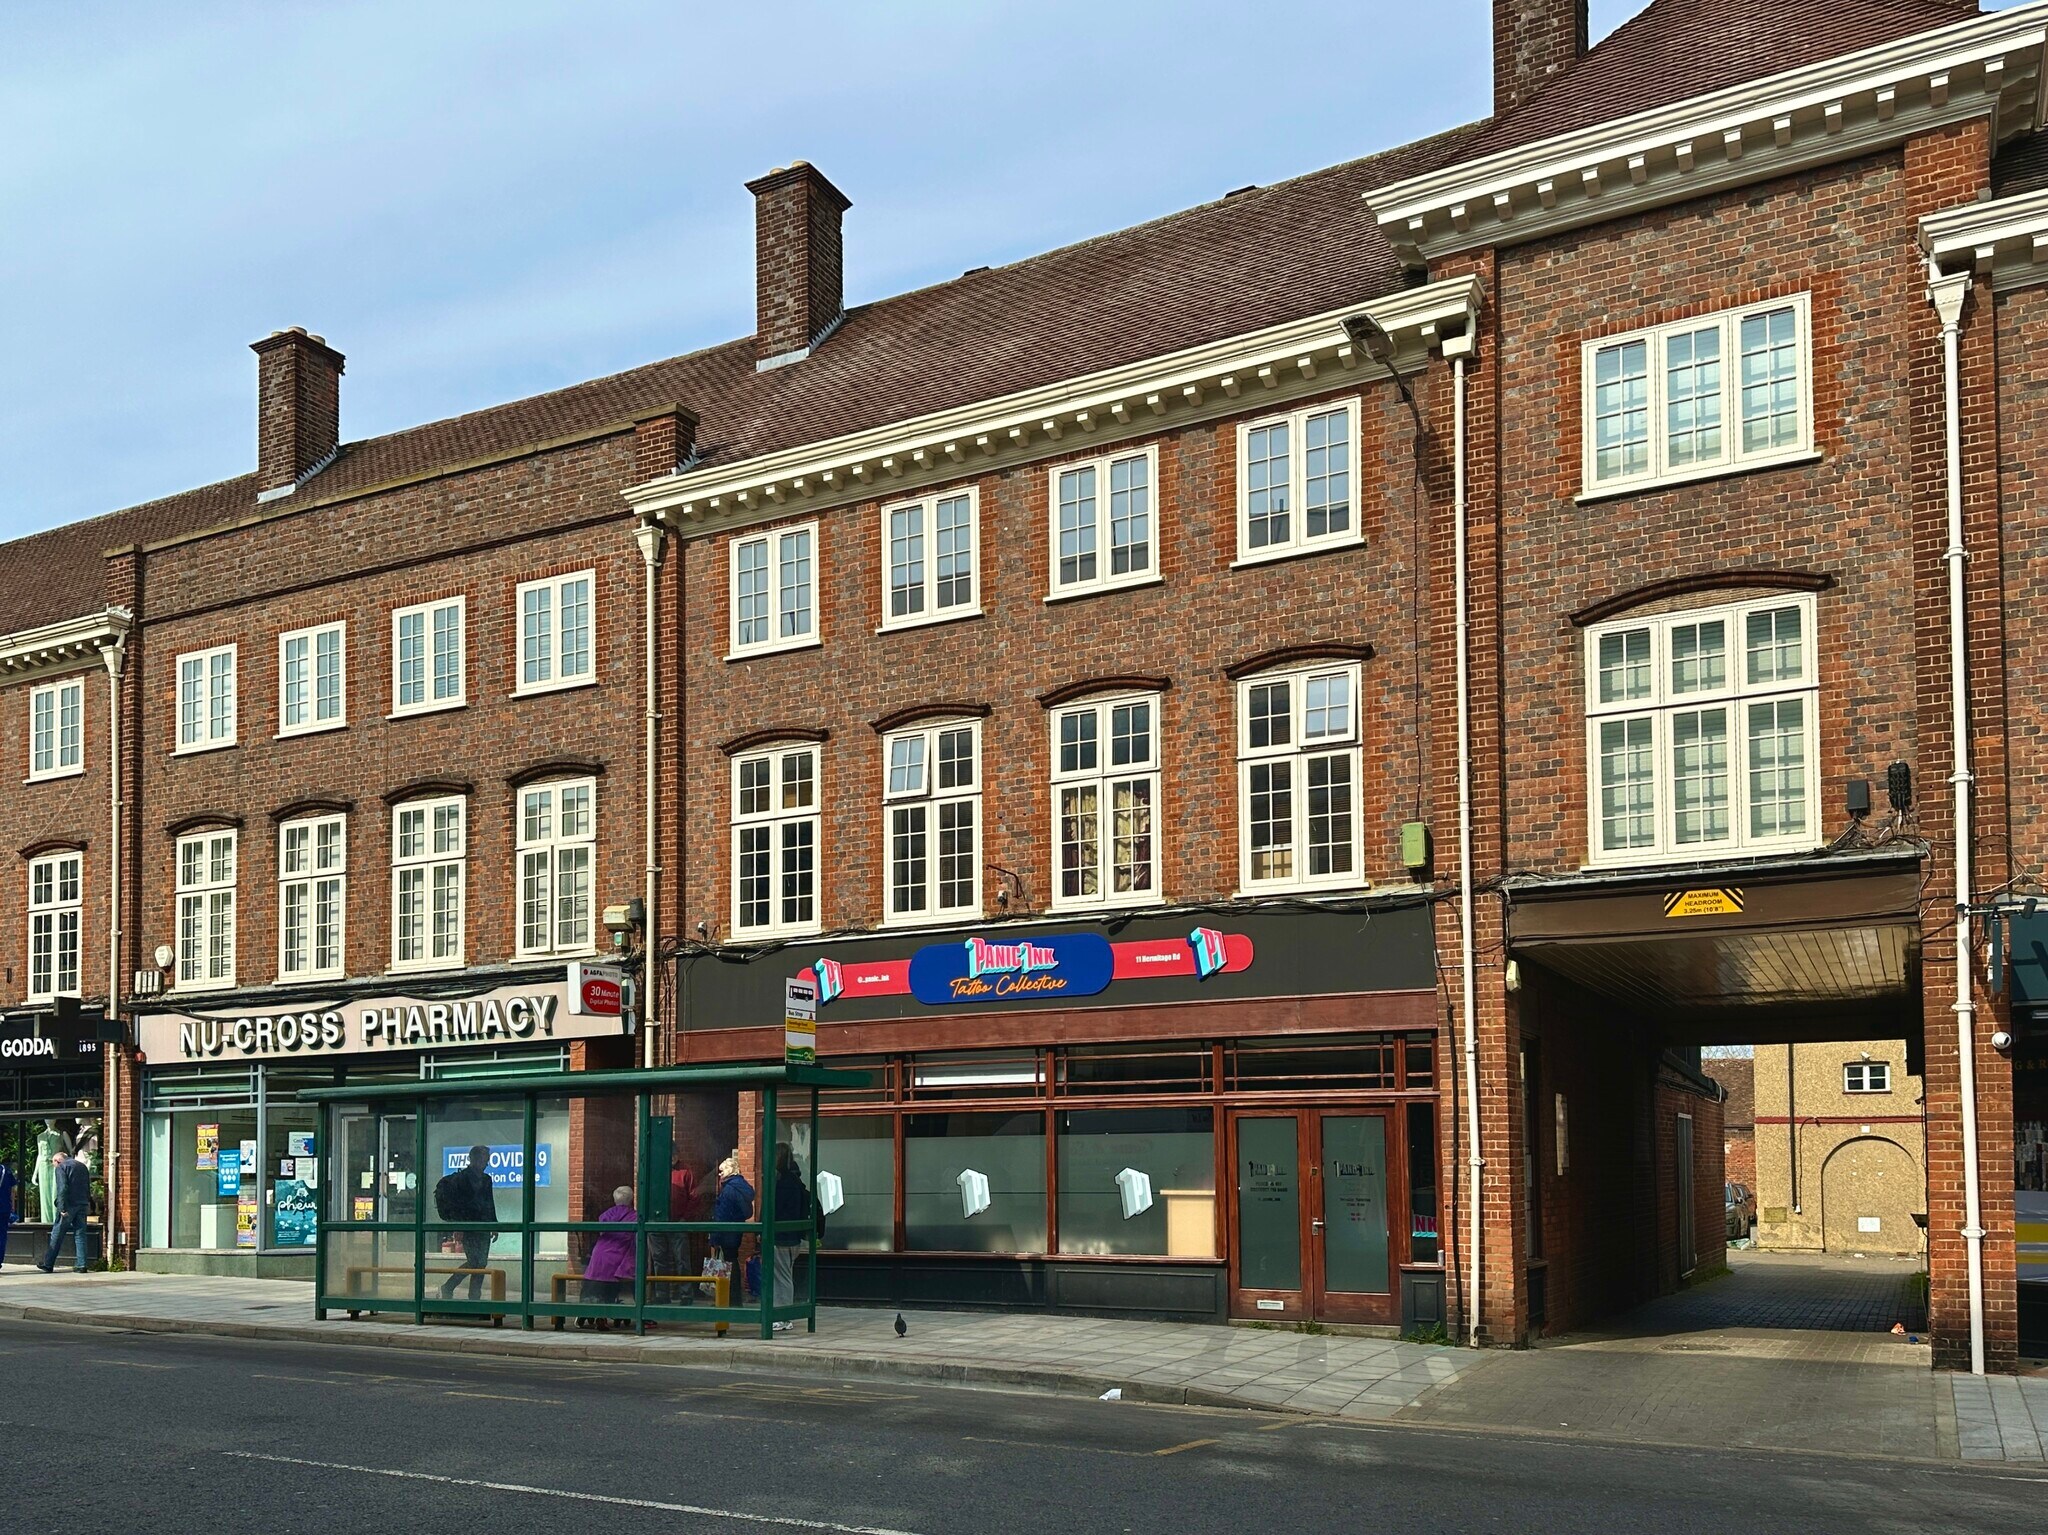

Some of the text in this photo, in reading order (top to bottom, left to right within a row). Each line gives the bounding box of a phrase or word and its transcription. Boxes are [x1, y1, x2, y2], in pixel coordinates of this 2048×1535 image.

[1684, 899, 1723, 907] HEADROOM
[1687, 891, 1719, 899] MAXIMUM
[965, 937, 1059, 979] PANIC INK
[1172, 953, 1181, 961] Rd
[591, 986, 619, 998] 30 Minute
[949, 974, 1068, 998] Tattoo Collective
[361, 995, 556, 1042] PHARMACY
[179, 1012, 344, 1054] NU-CROSS
[1, 1037, 54, 1057] GODDA
[488, 1150, 547, 1168] OVID9
